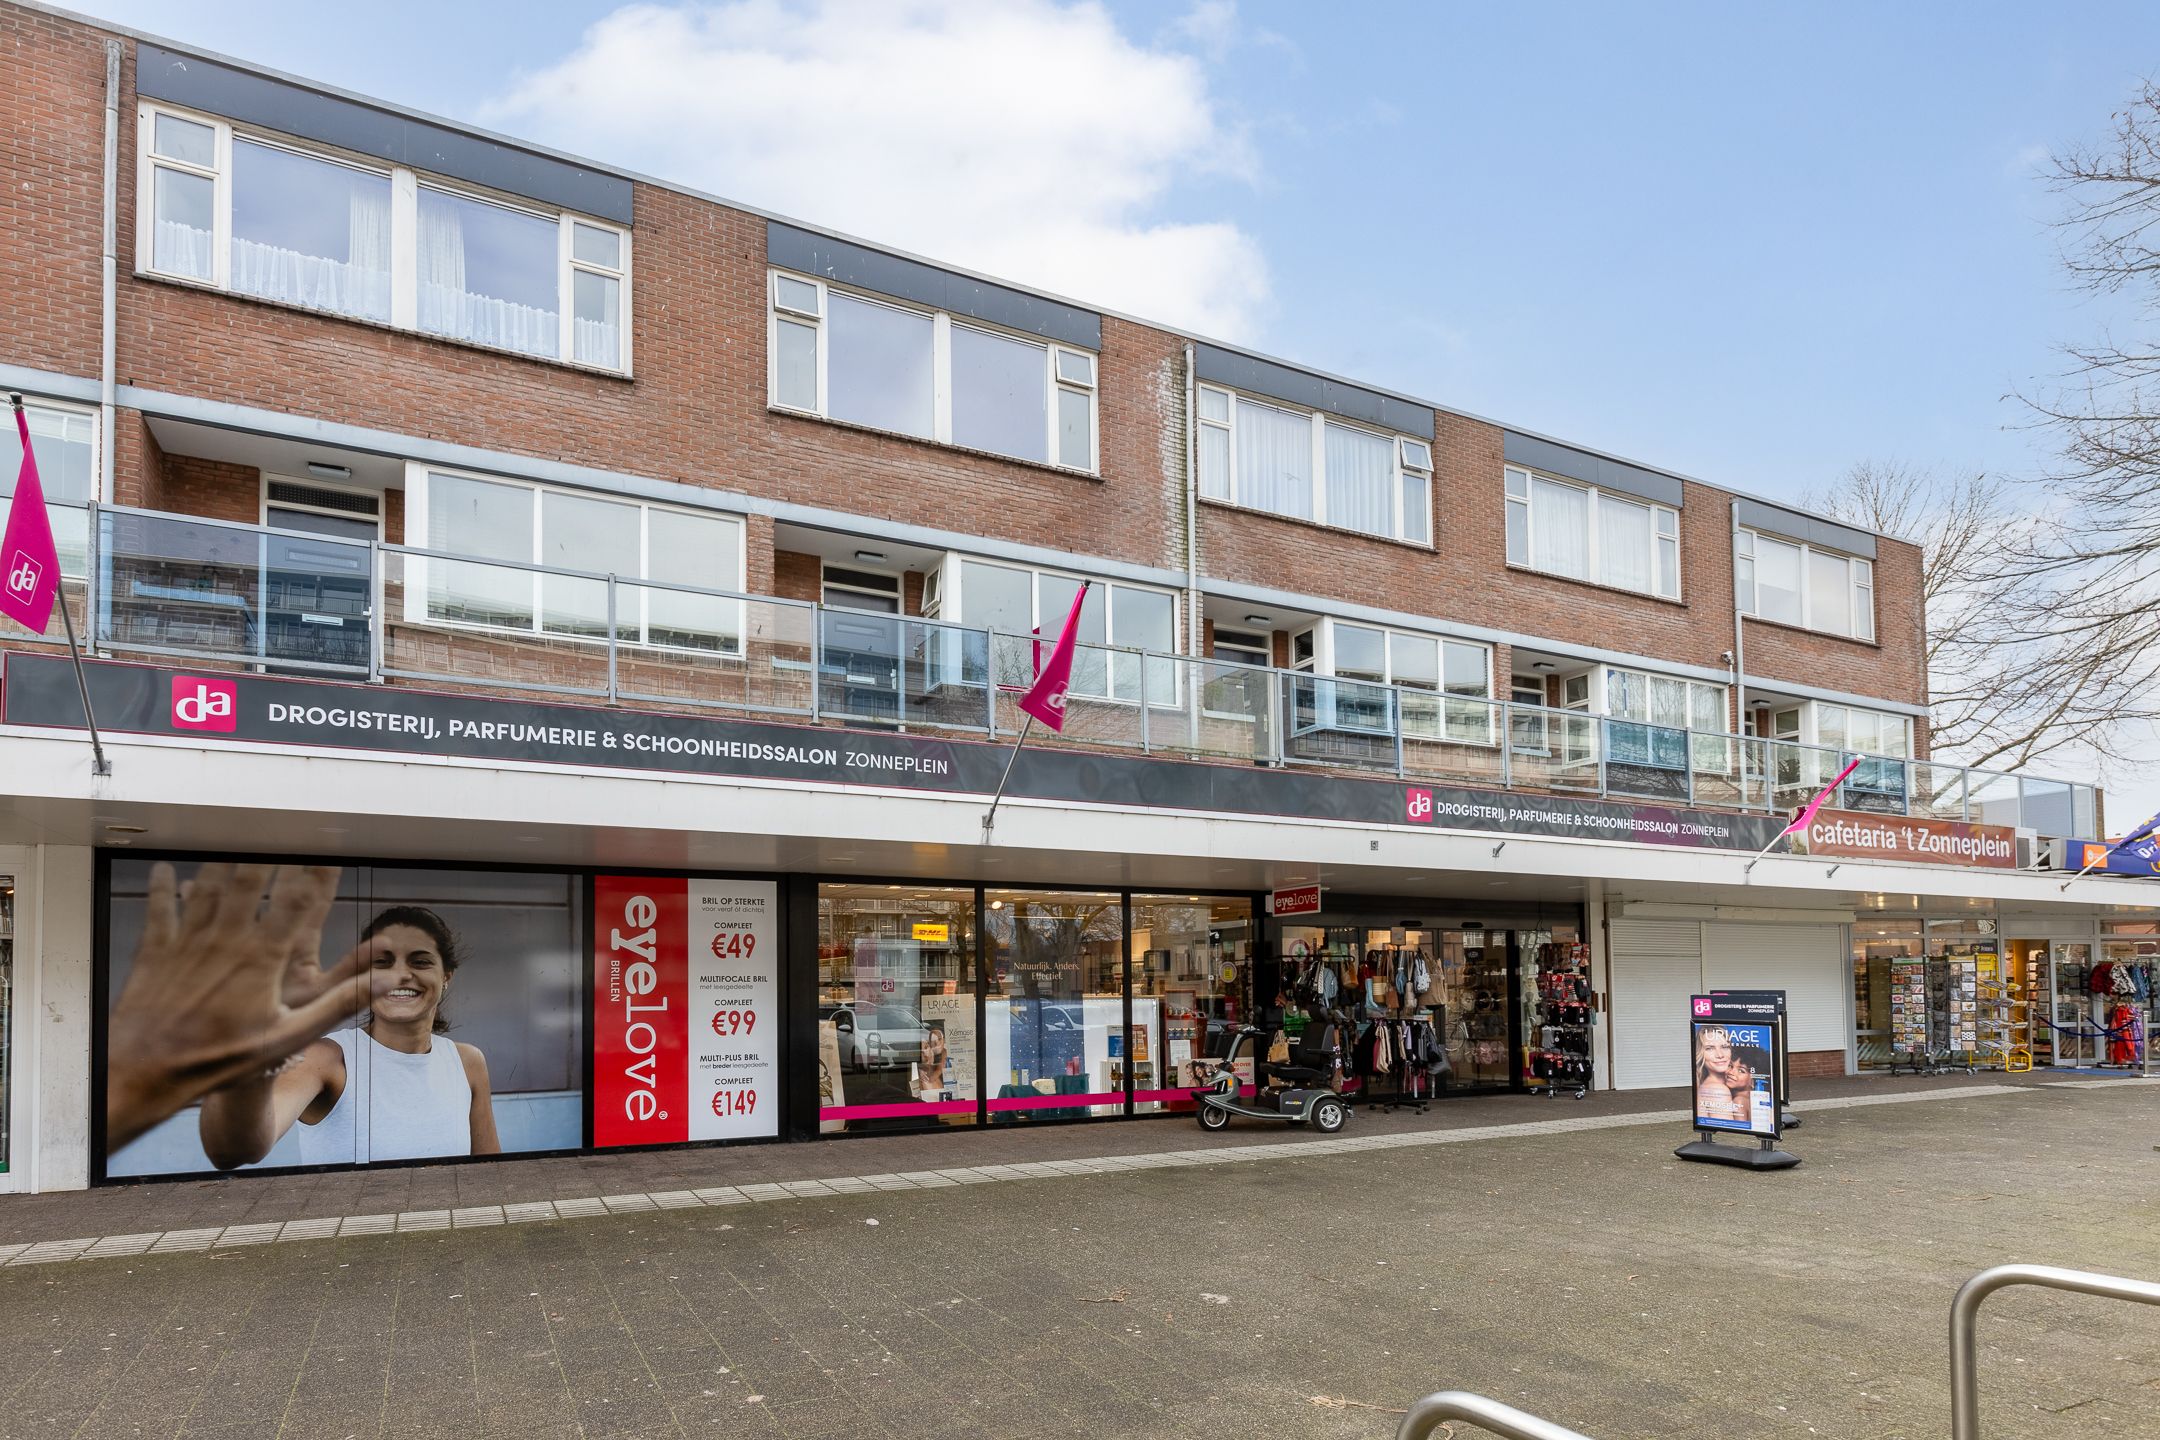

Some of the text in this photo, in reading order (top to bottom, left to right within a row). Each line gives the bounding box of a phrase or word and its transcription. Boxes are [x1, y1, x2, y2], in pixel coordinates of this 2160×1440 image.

[10, 562, 36, 591] da
[175, 684, 231, 723] da
[268, 703, 948, 775] DROGISTERIJ, PARFUMERIE & SCHOONHEIDSSALON ZONNEPLEIN
[1408, 793, 1431, 817] da
[1437, 802, 1729, 838] DROGISTERIJ, PARFUMERIE & SCHOONHEIDSSALON ZONNEPLEIN
[1812, 820, 1897, 850] cafetaria
[1917, 828, 2010, 861] Zonneplein
[702, 897, 765, 906] BRIL OP STERKTE
[1275, 893, 1317, 911] eyelove
[711, 933, 756, 959] €49
[611, 960, 620, 1002] BRILLEN
[881, 980, 894, 991] da
[1695, 1001, 1710, 1014] da
[711, 1010, 756, 1036] €99
[1704, 1029, 1759, 1042] URIAGE
[699, 1053, 759, 1062] MULTI-PLUS BRIL
[711, 1089, 757, 1116] €149
